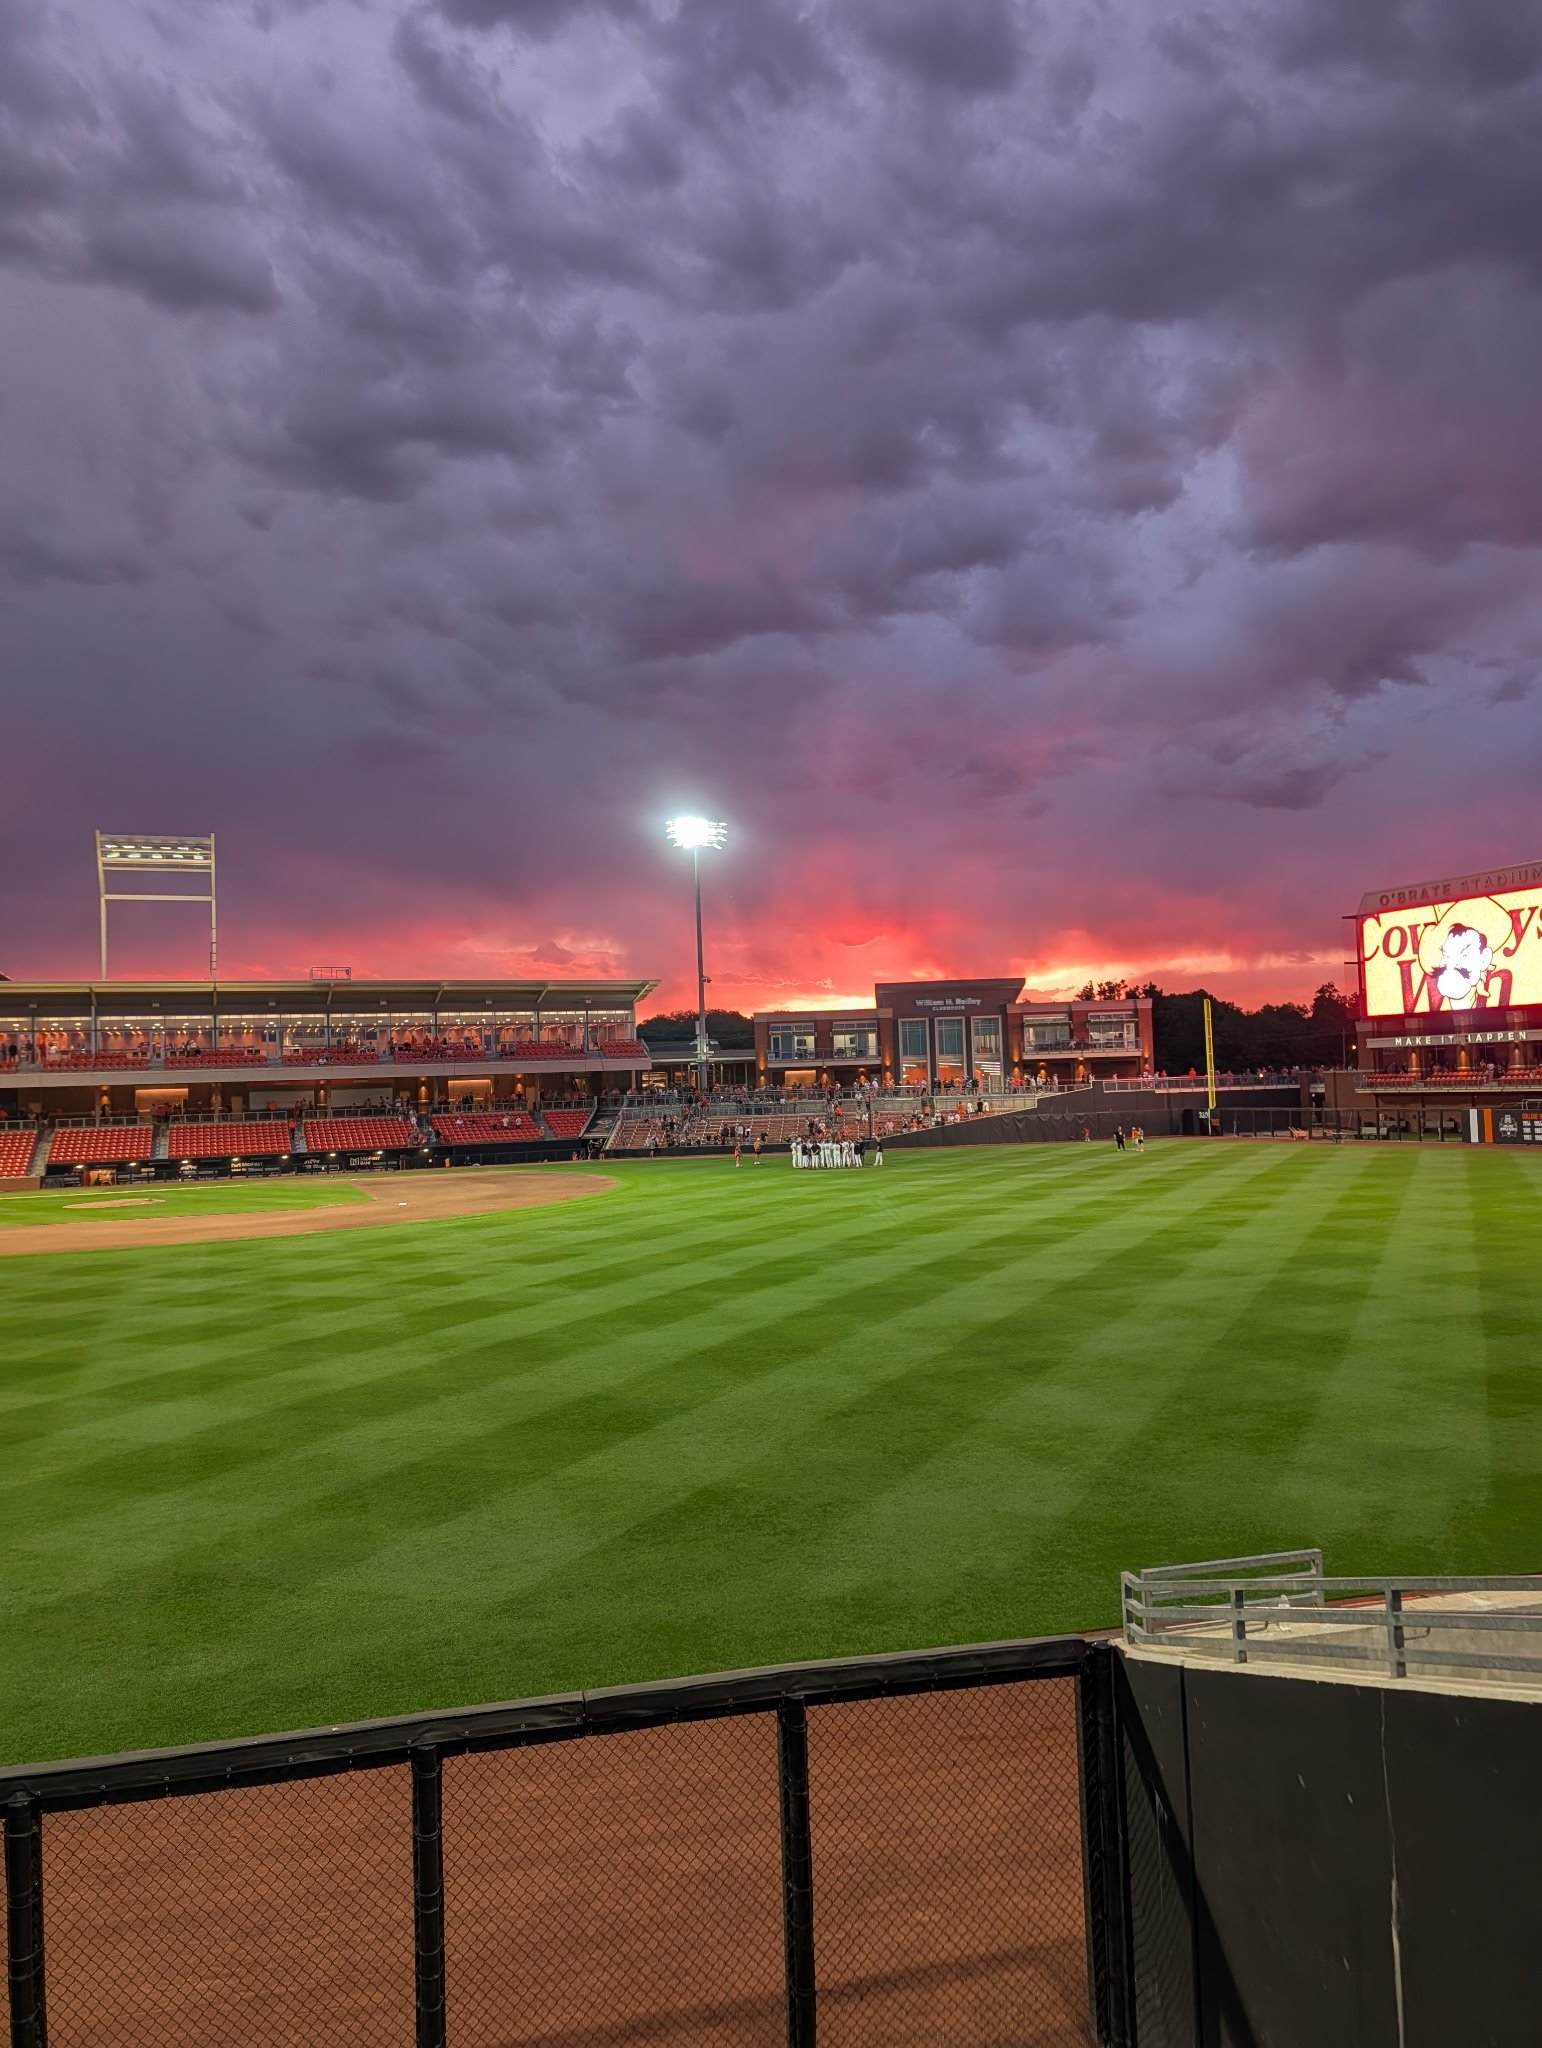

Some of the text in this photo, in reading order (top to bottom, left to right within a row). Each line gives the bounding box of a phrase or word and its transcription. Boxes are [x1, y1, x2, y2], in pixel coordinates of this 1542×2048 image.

[1379, 884, 1452, 907] O'BRATE
[1395, 1036, 1431, 1046] MAKE
[1441, 1035, 1454, 1044] IT
